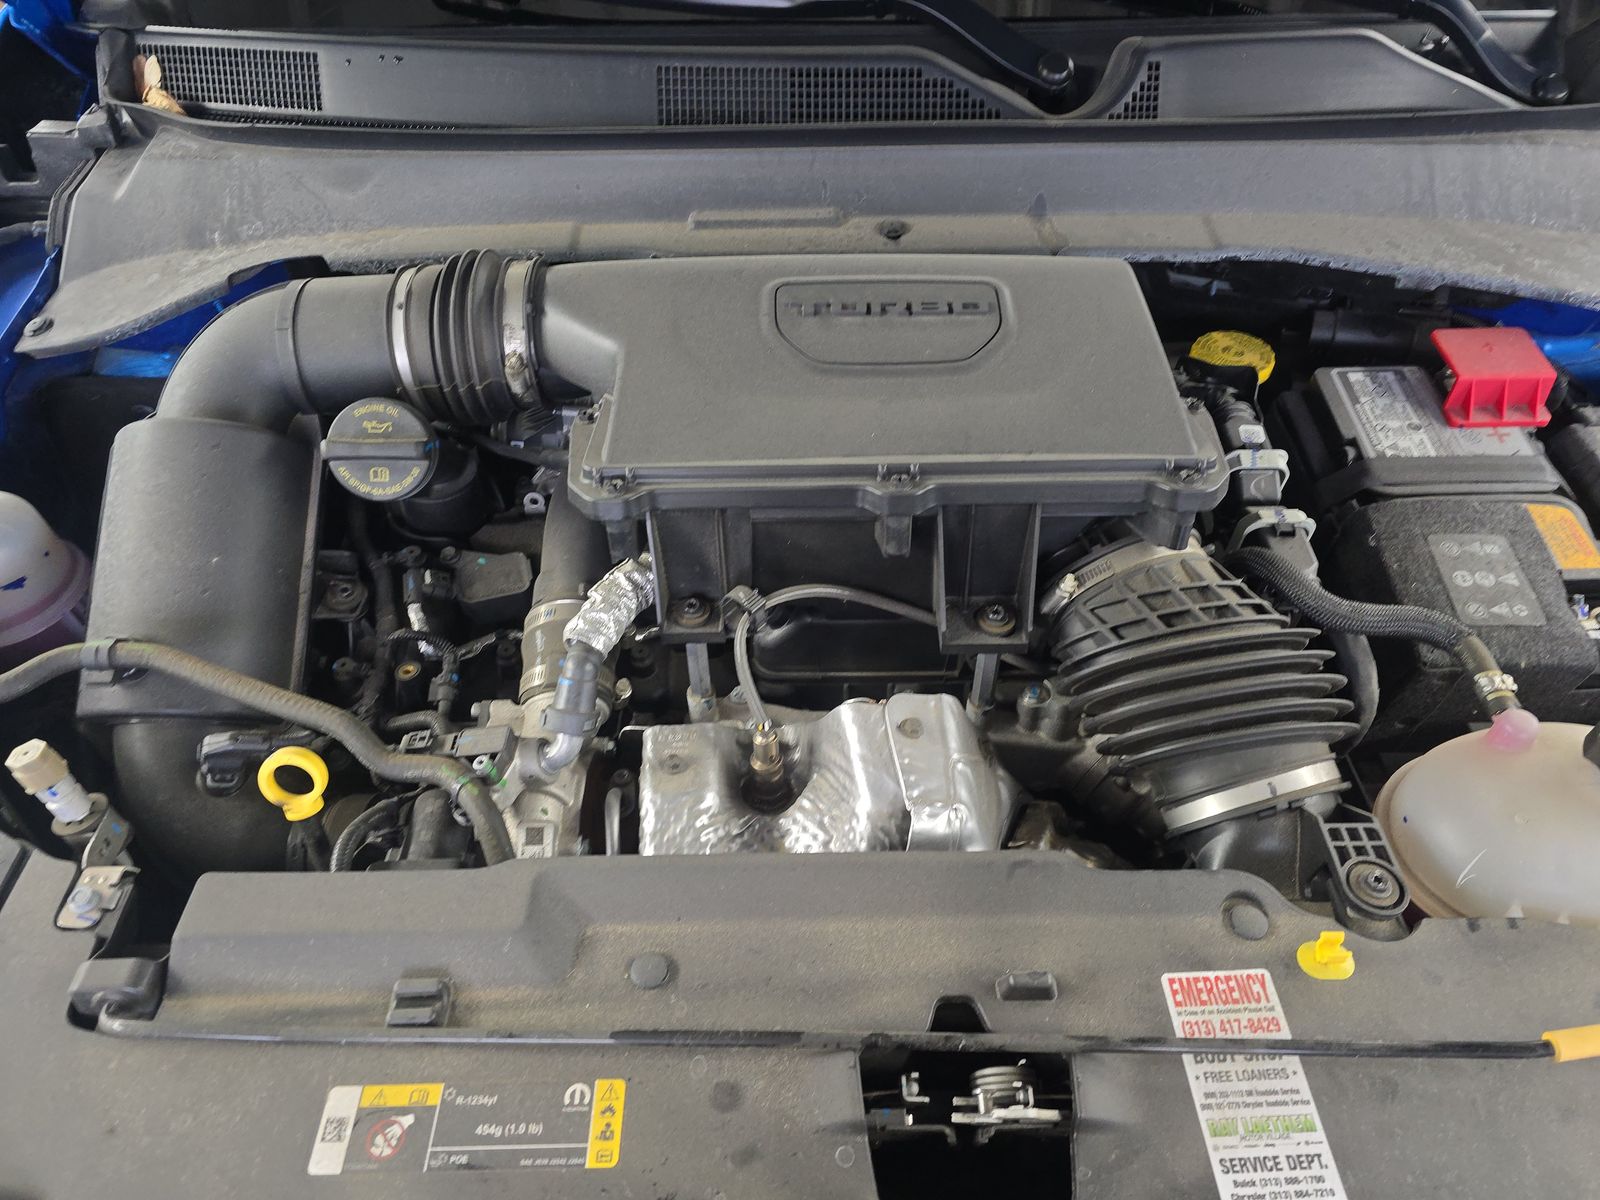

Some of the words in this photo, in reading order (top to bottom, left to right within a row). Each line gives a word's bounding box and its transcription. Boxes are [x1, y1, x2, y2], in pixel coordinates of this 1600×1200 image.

[353, 404, 385, 417] ENGINE
[386, 406, 400, 418] OIL
[1168, 973, 1271, 1009] EMERGENCY
[1181, 1018, 1217, 1038] (313)
[1219, 1017, 1281, 1036] 417-8429
[1203, 1070, 1234, 1083] FREE
[1235, 1068, 1290, 1082] LOANERS
[474, 1123, 503, 1137] 454g
[504, 1123, 527, 1137] (1.0
[528, 1123, 544, 1137] lb)
[1206, 1117, 1239, 1138] RAY
[1240, 1113, 1317, 1135] LAETHEM
[1219, 1154, 1284, 1174] SERVICE
[1285, 1153, 1329, 1171] DEPT.
[1233, 1177, 1257, 1188] Buick
[1259, 1176, 1282, 1189] (313)
